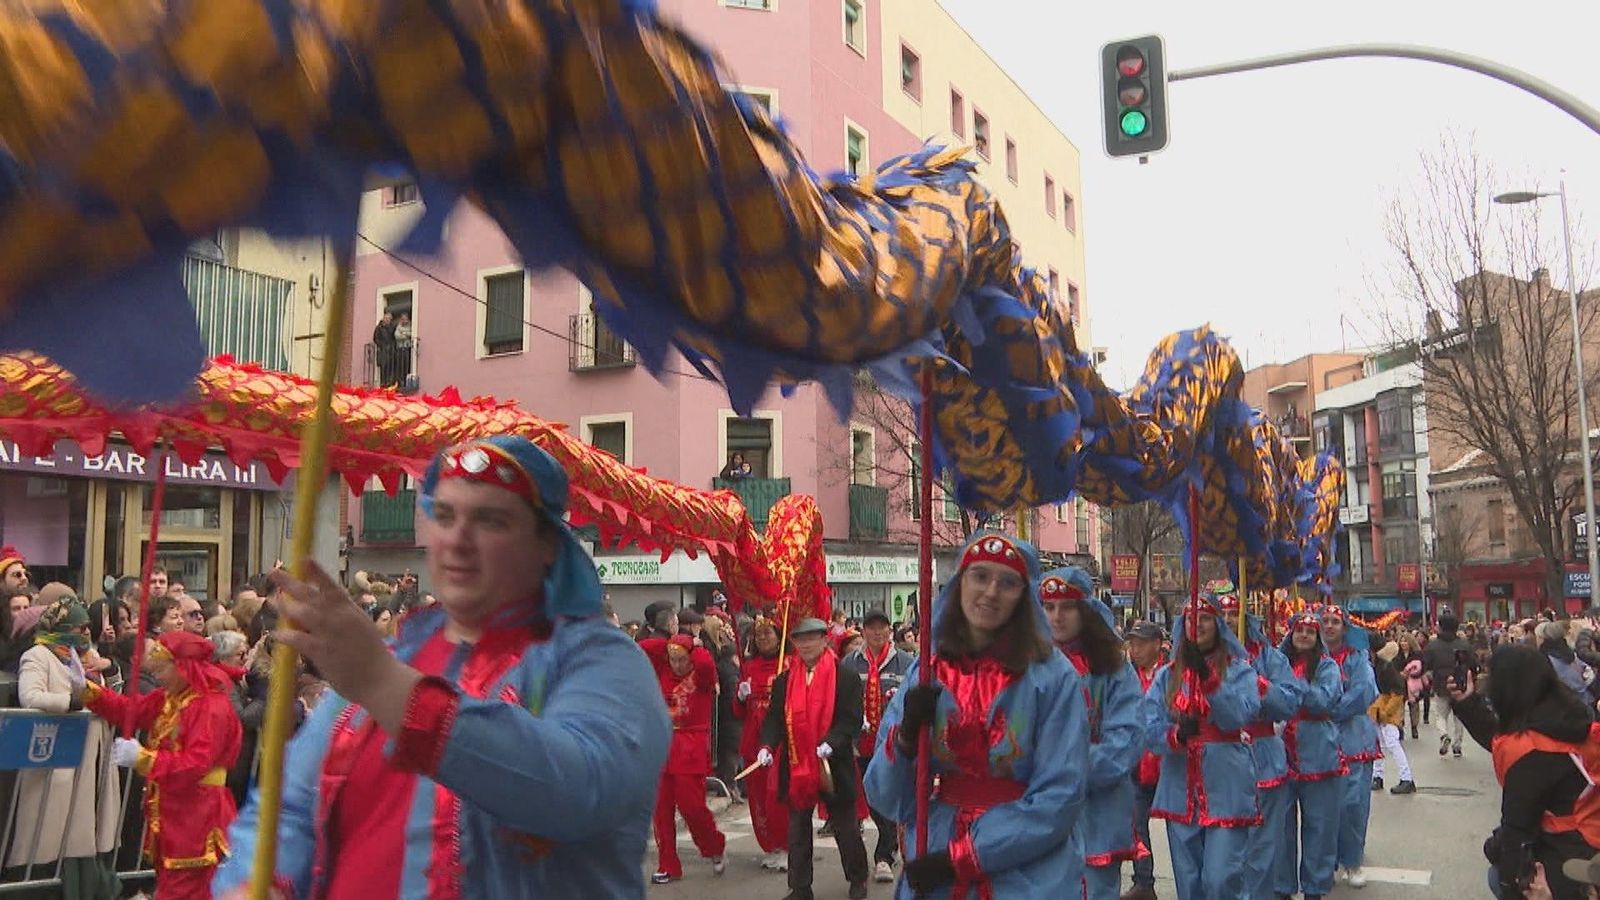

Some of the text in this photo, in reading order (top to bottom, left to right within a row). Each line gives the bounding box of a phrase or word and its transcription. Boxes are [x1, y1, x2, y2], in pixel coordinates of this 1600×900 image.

[83, 451, 145, 474] BAR
[165, 456, 227, 480] LIRA
[611, 561, 659, 575] TECNOCASA
[1569, 573, 1590, 581] ESCU
